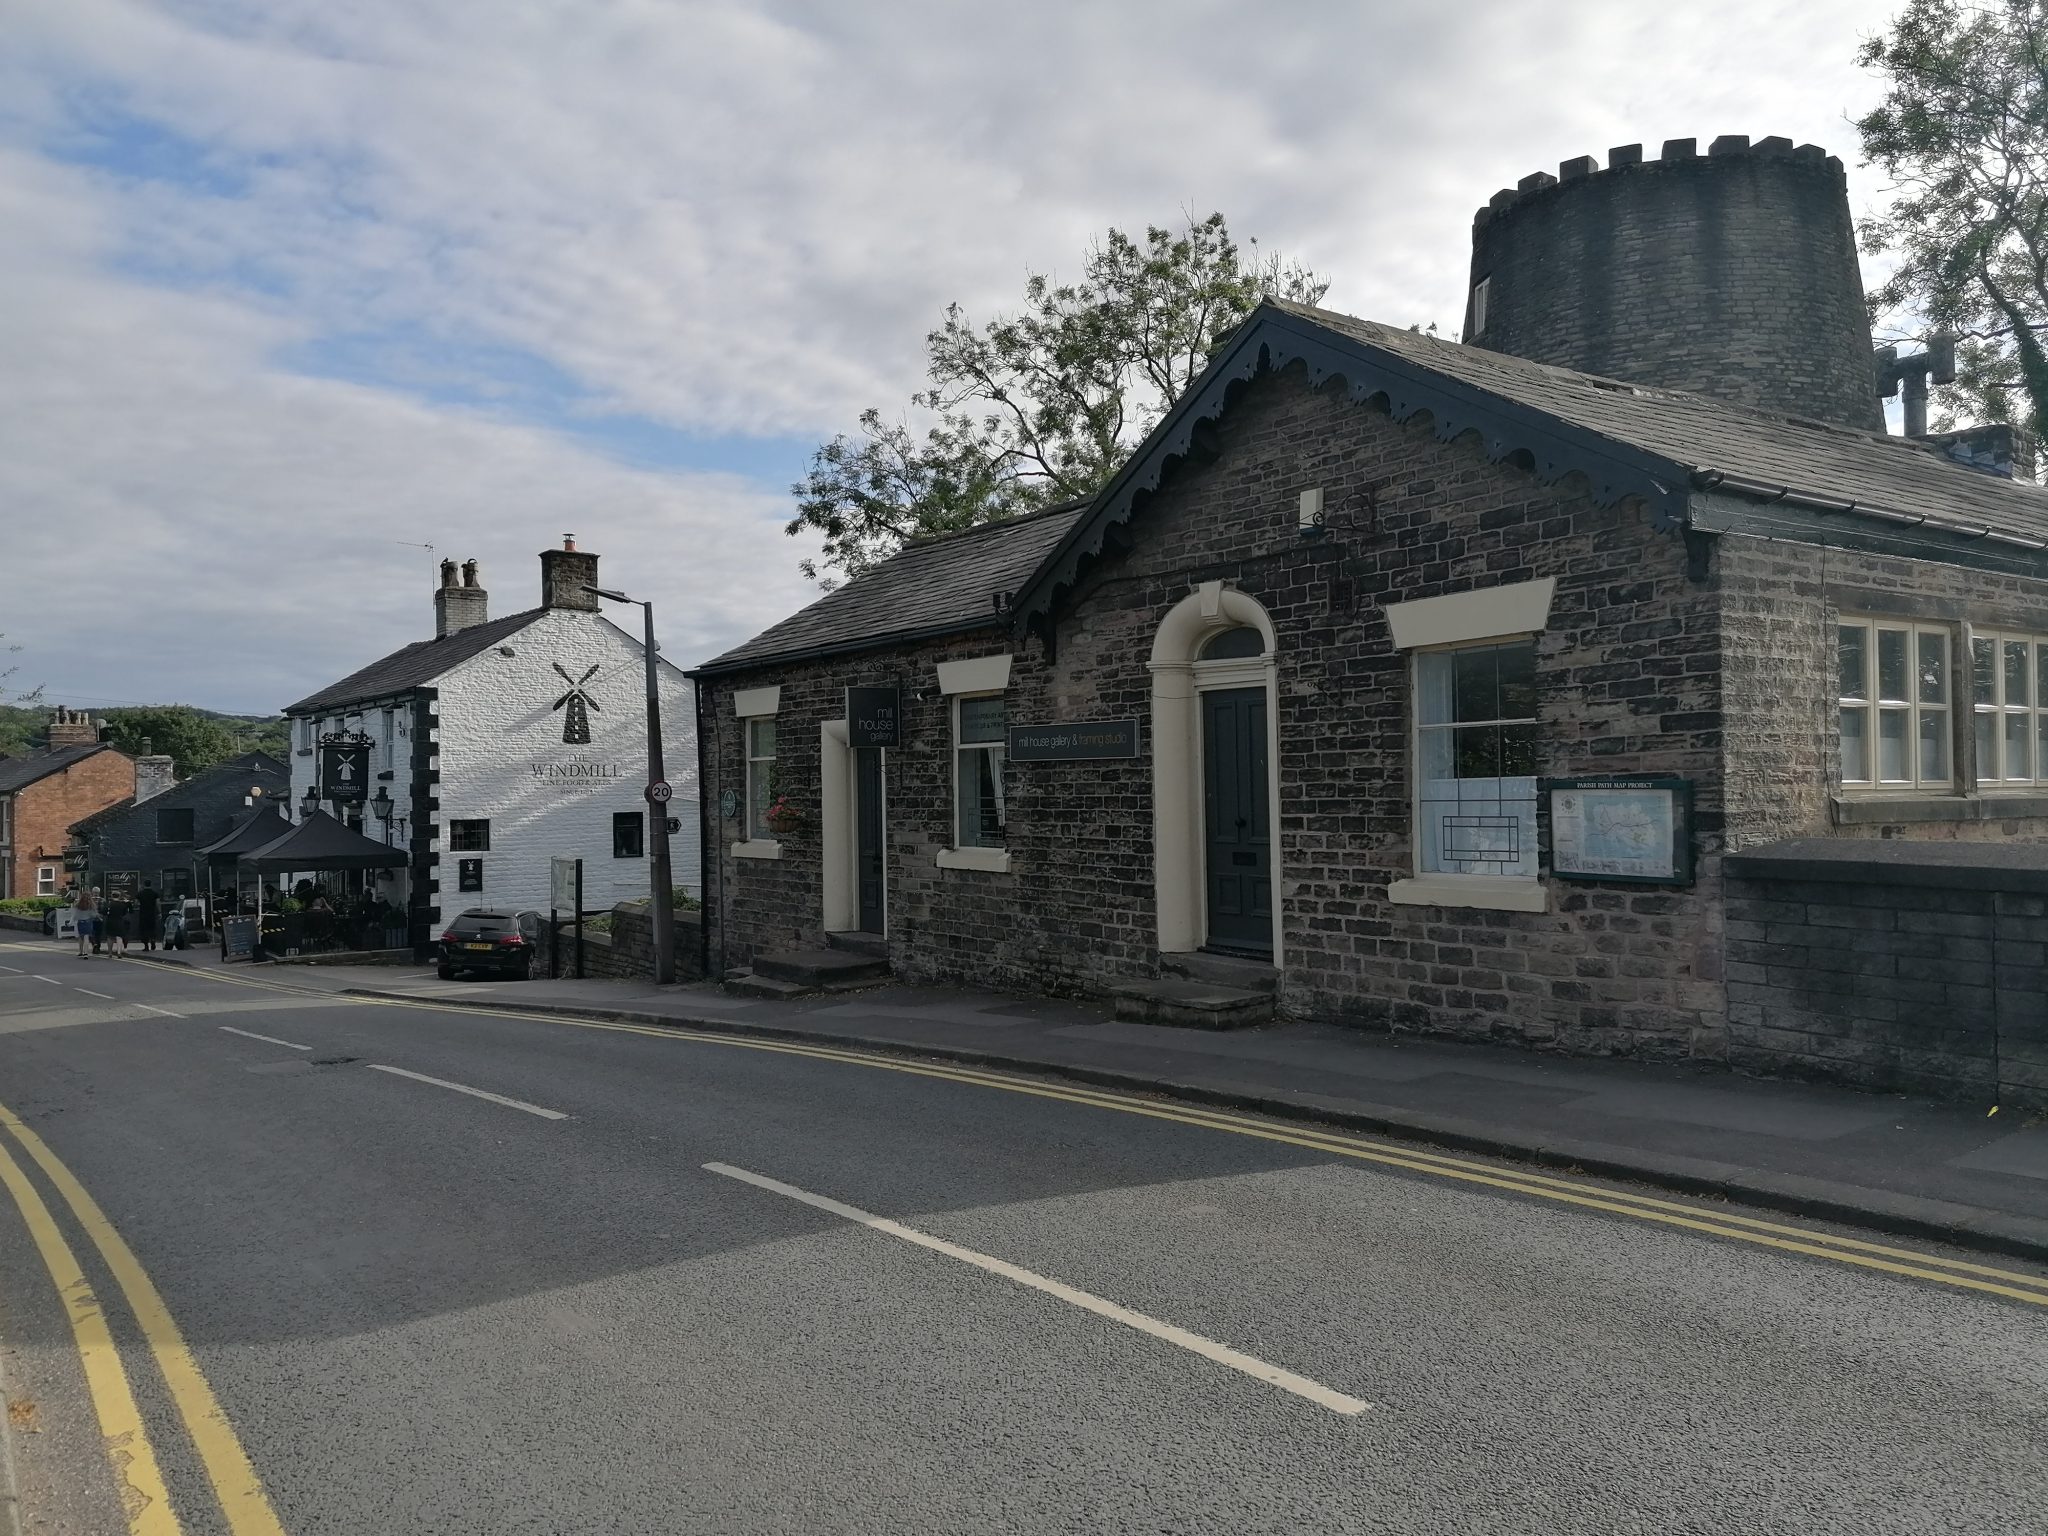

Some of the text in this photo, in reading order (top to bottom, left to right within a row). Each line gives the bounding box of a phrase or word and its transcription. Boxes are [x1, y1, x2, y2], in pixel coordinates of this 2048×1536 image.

[877, 706, 893, 718] mill
[858, 716, 894, 730] house
[870, 731, 894, 742] gallery
[1018, 731, 1127, 749] mill house gallery & framing studio
[530, 764, 623, 777] WINDMILL
[653, 787, 669, 797] 20
